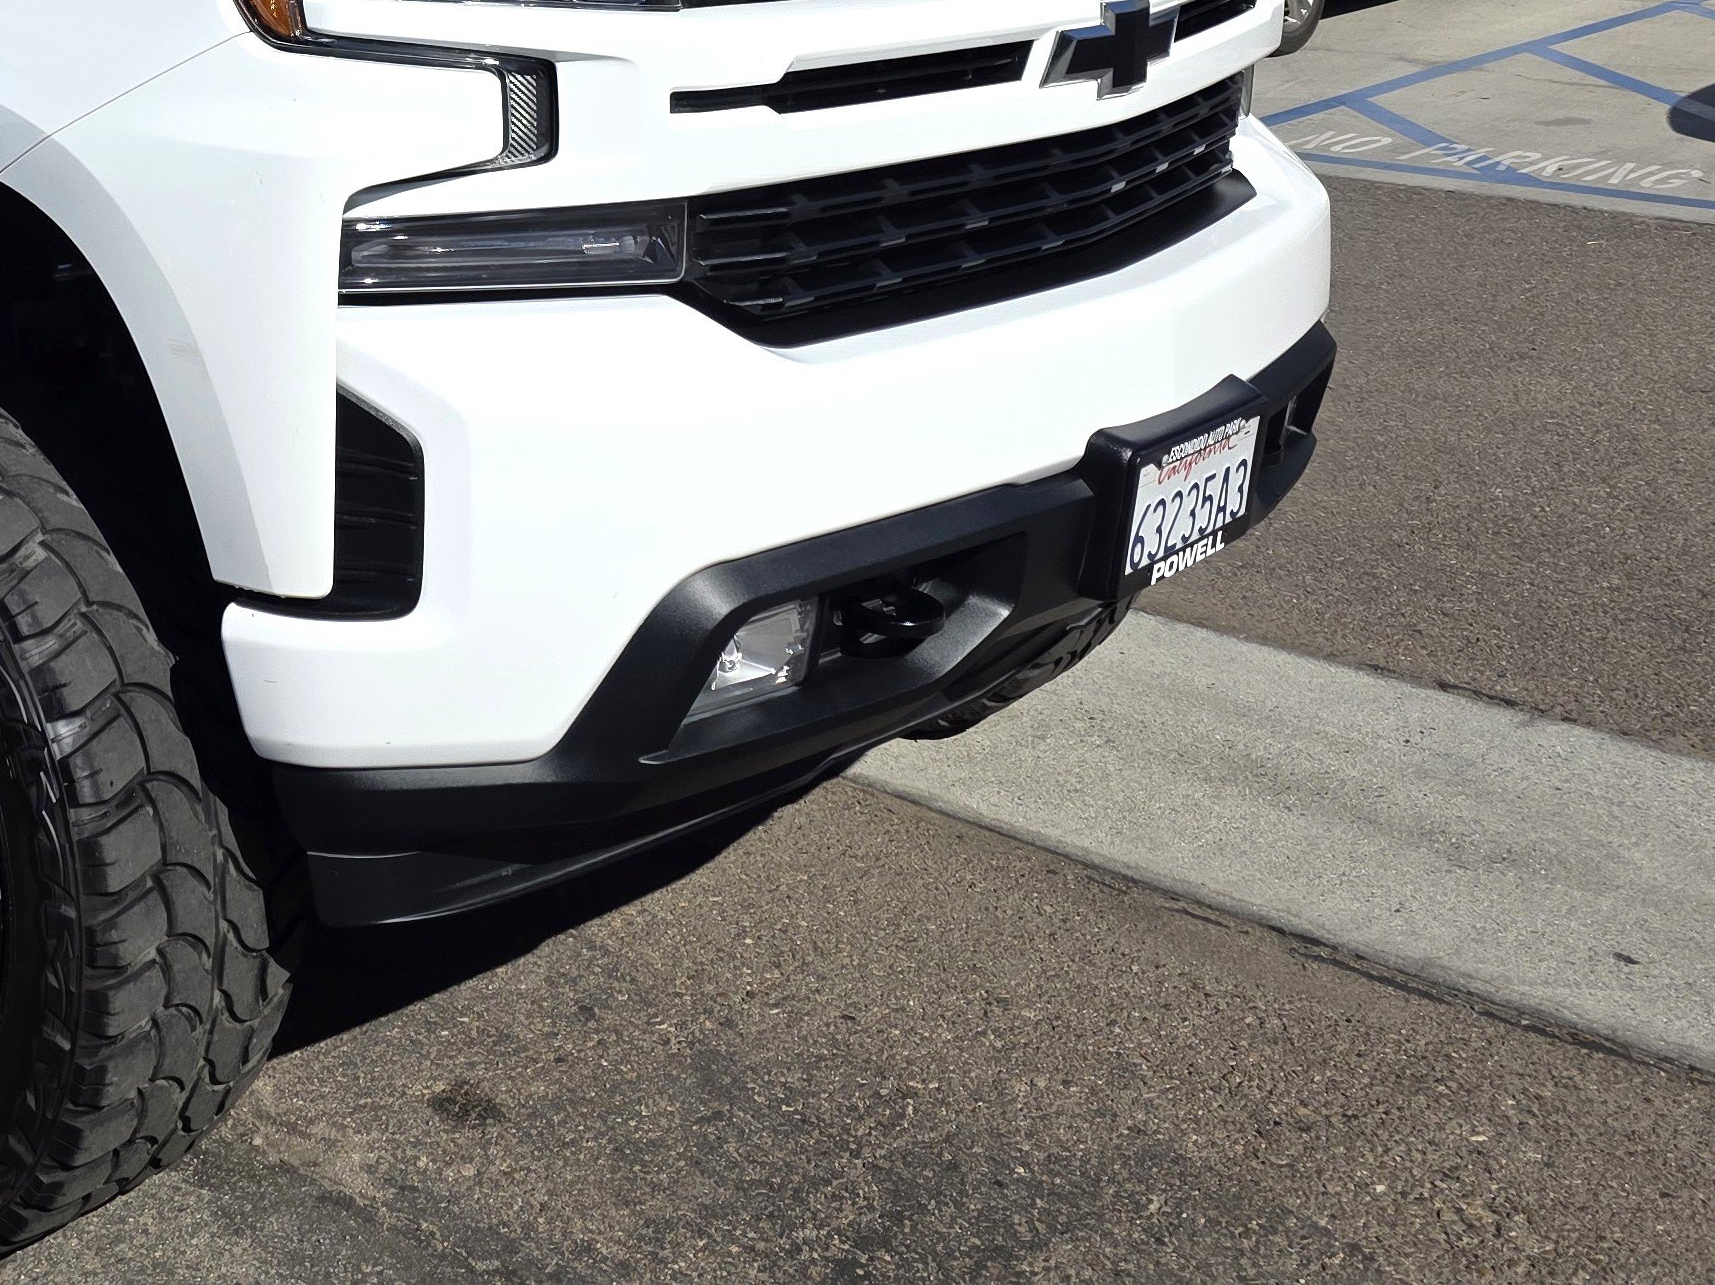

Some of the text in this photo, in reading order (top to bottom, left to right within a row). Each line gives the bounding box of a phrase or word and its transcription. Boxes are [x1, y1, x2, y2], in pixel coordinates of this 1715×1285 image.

[1285, 130, 1705, 189] NO PARKING
[1157, 437, 1238, 486] California
[1167, 417, 1243, 463] ESCONDIDO AUTO PARK
[1129, 458, 1249, 571] 63235A3
[1150, 530, 1226, 586] POWELL
